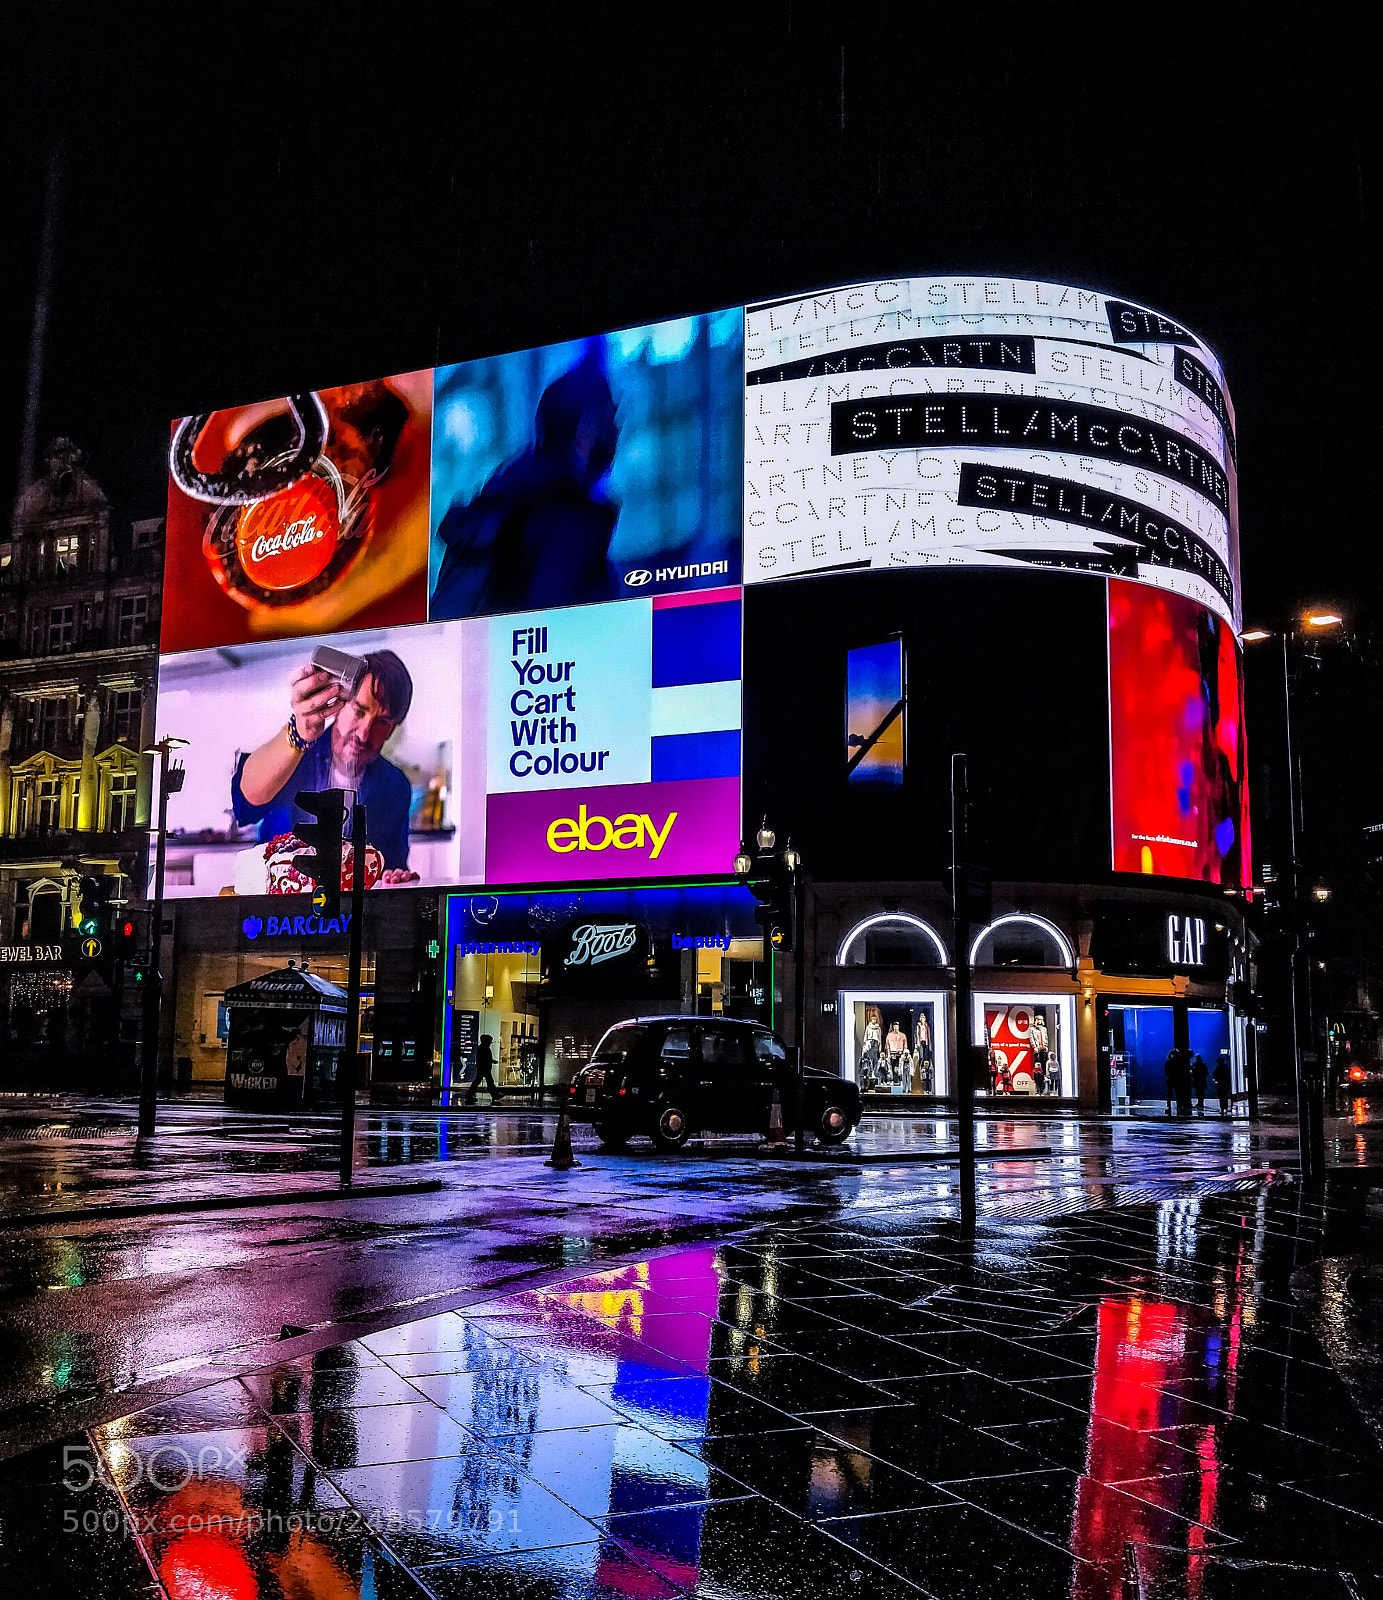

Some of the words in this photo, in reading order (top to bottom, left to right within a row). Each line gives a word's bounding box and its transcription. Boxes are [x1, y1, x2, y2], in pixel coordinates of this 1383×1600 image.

[655, 560, 728, 582] HYUNDAI
[512, 626, 548, 656] Fill
[510, 658, 576, 686] Your
[510, 685, 576, 716] Cart
[510, 716, 577, 746] With
[509, 747, 610, 777] Colour
[546, 804, 679, 859] ebay
[34, 945, 62, 961] BAR
[460, 939, 541, 958] pharmacy
[564, 922, 637, 966] Boots
[670, 932, 732, 952] beauty
[1167, 914, 1205, 965] GAP
[984, 1005, 1035, 1039] 70
[230, 1073, 278, 1090] WICKED
